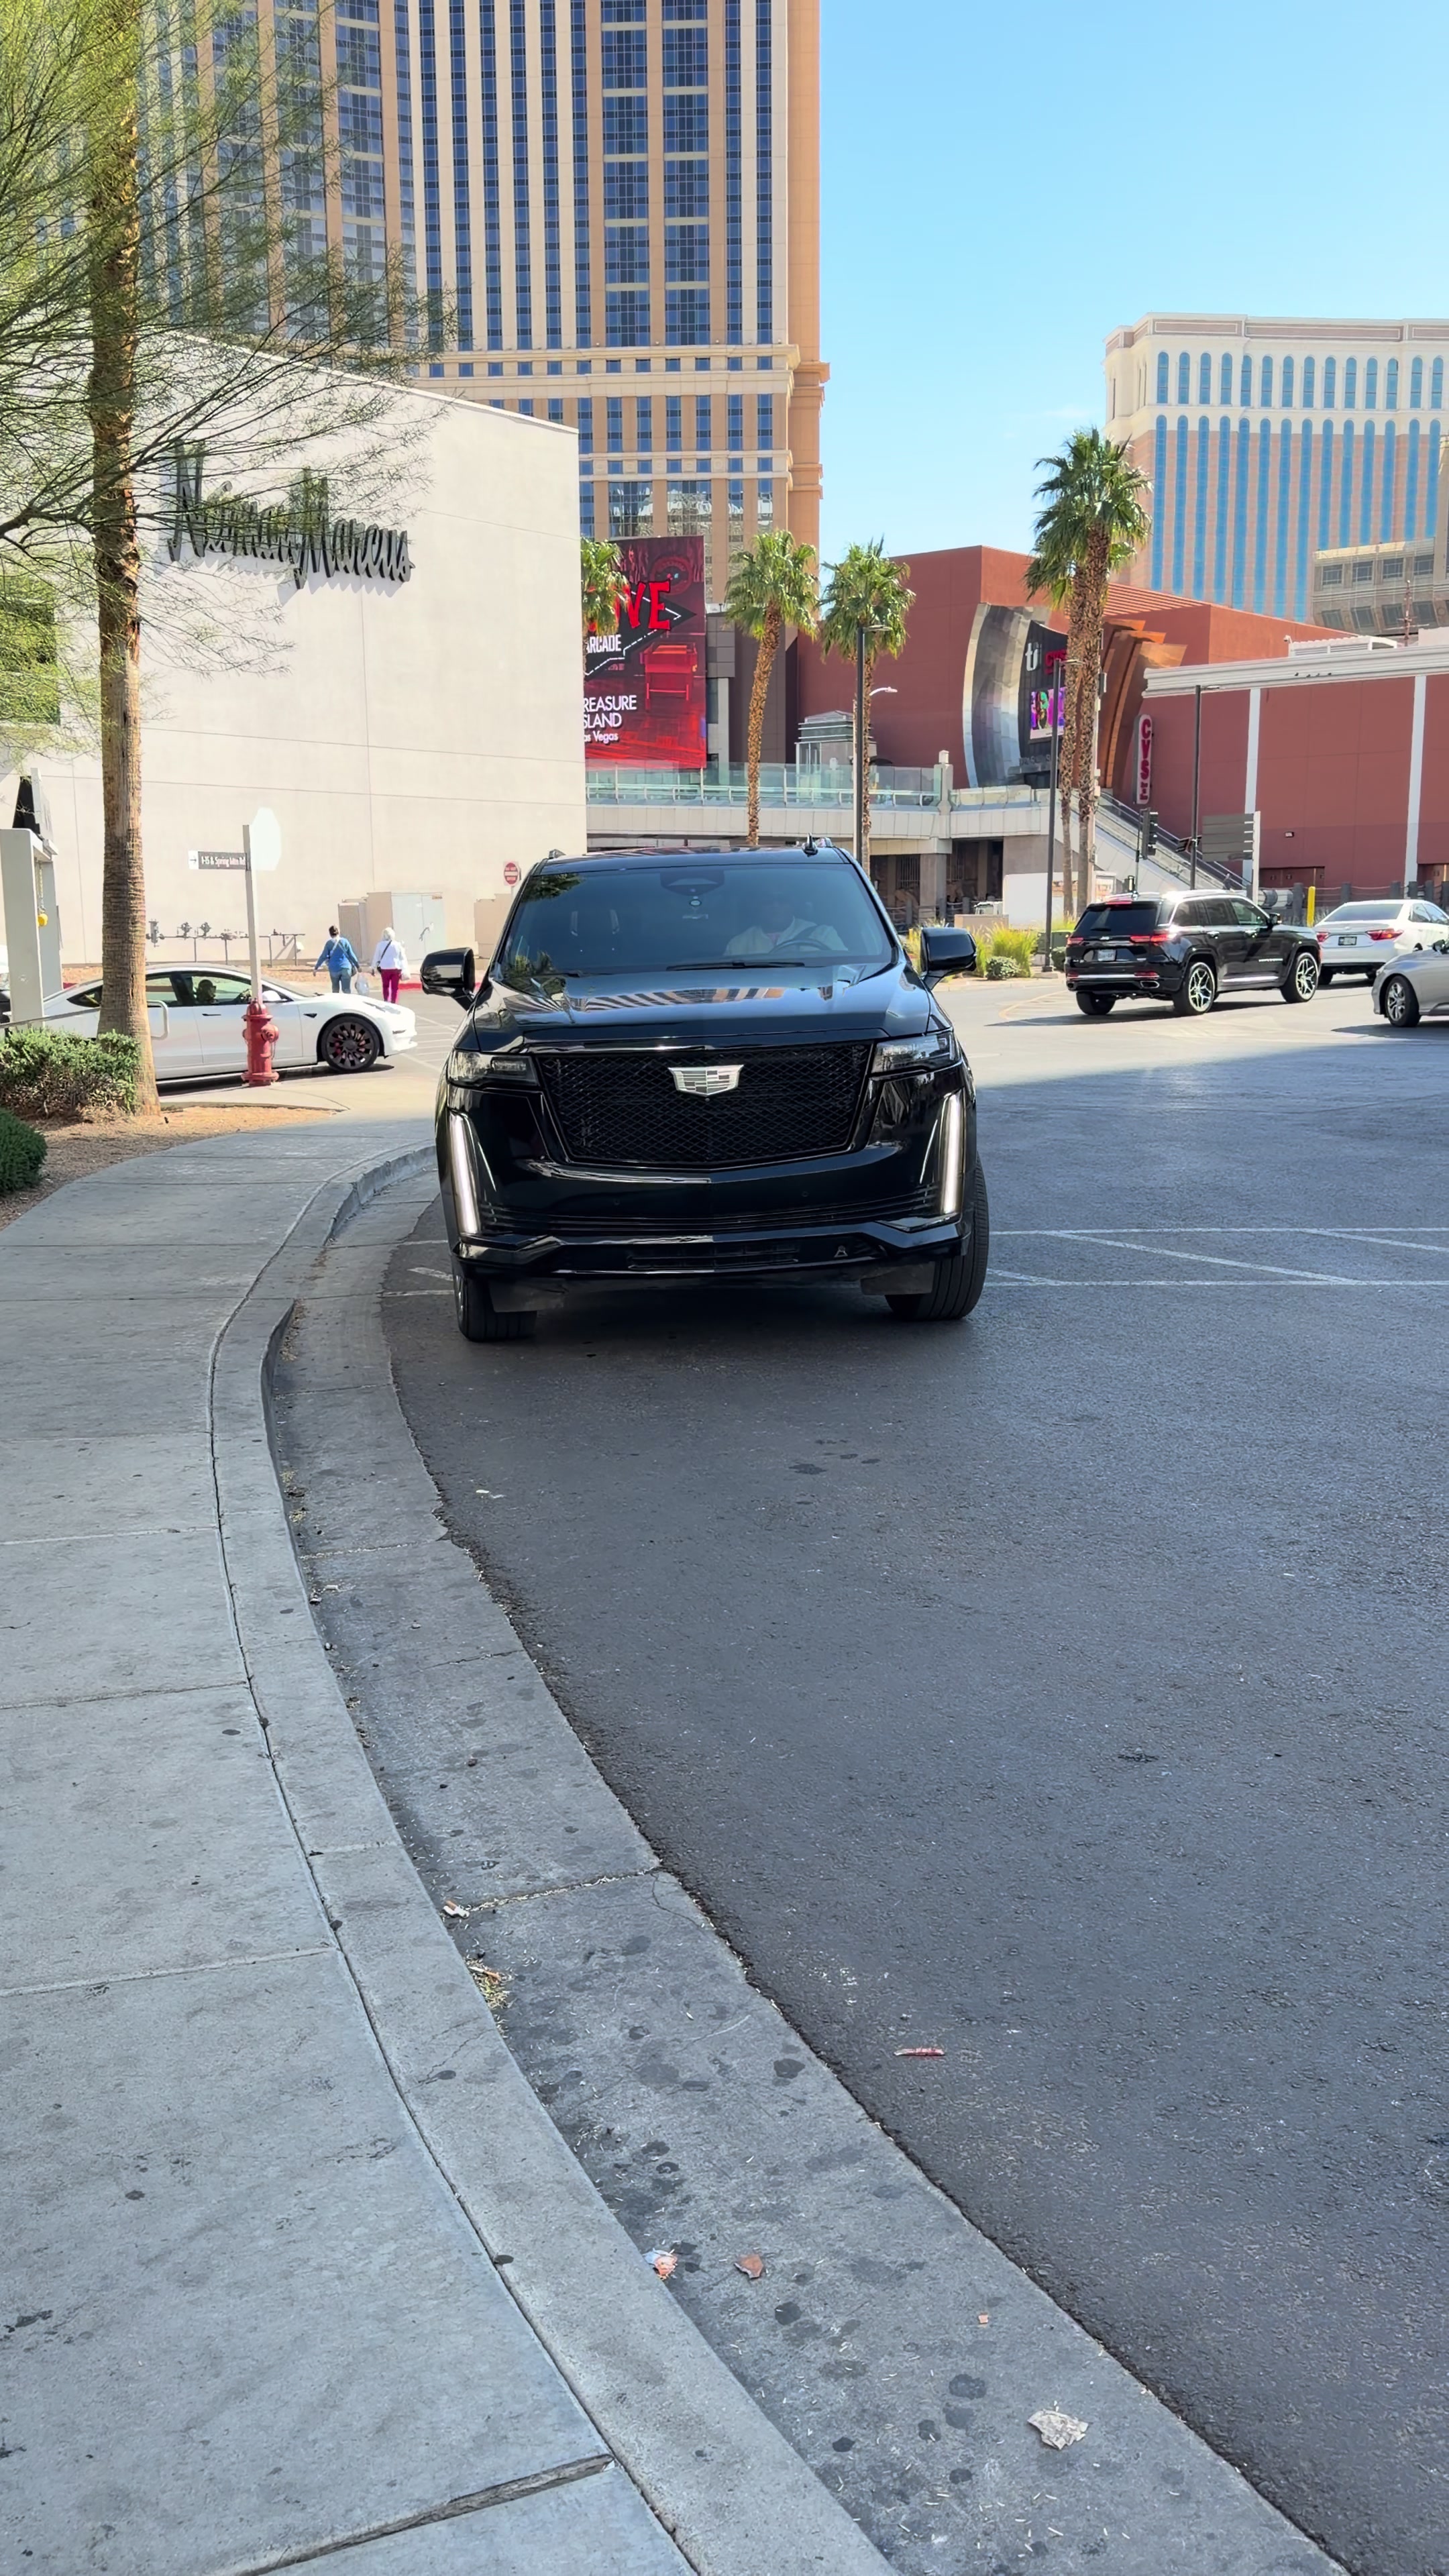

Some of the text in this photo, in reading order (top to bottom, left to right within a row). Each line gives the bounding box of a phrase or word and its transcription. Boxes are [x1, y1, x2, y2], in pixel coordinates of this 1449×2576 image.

[293, 466, 415, 589] Marcus
[584, 695, 637, 712] REASURE
[584, 712, 622, 729] SLAND
[592, 731, 619, 744] Vegas
[1140, 718, 1151, 780] CVS
[215, 856, 229, 867] Spring
